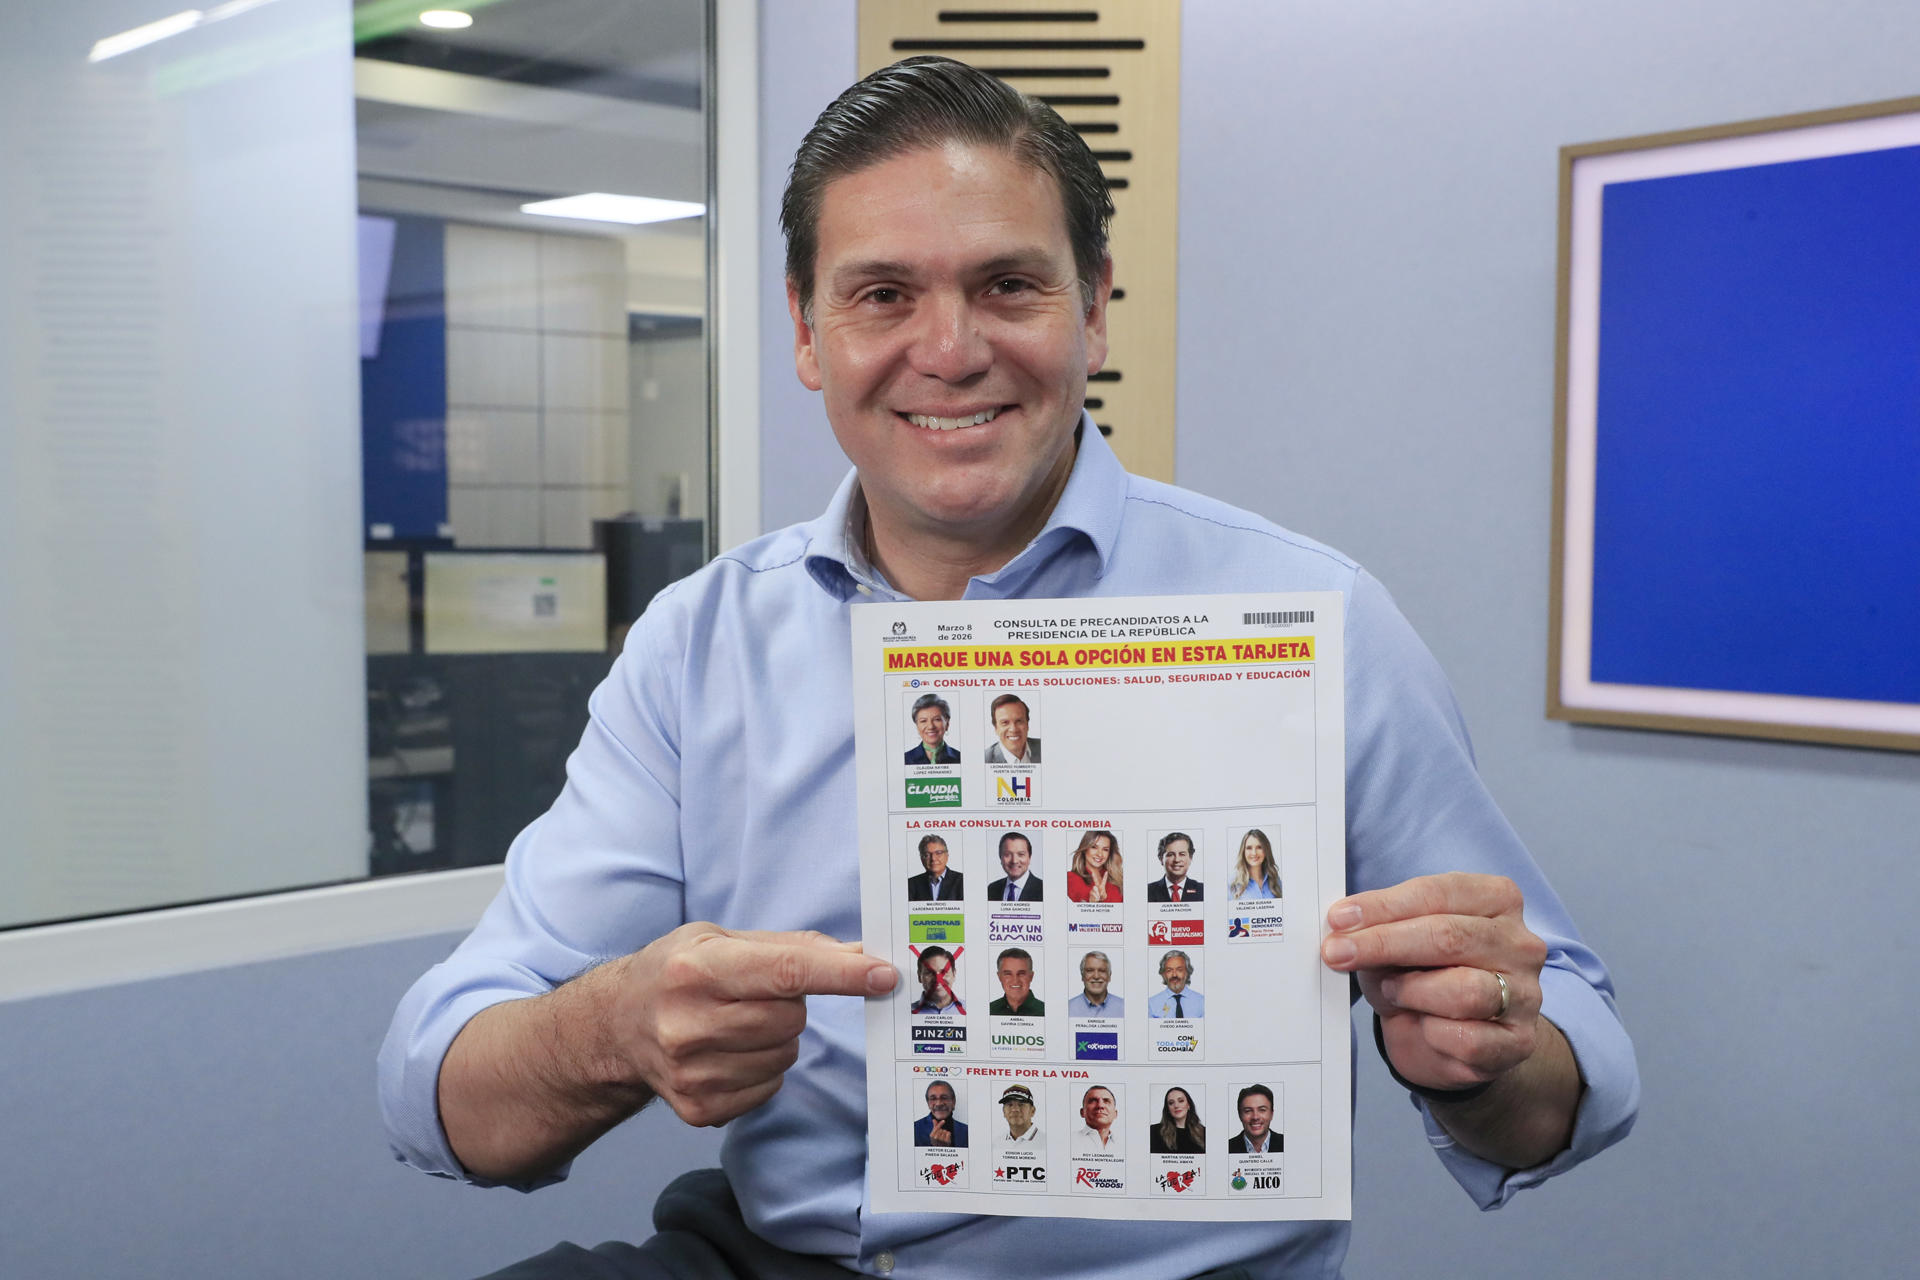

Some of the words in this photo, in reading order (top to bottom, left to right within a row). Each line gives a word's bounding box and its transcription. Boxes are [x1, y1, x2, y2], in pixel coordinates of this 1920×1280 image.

[994, 619, 1057, 628] CONSULTA
[1061, 618, 1076, 627] DE
[1080, 616, 1180, 626] PRECANDIDATOS
[1183, 615, 1191, 623] A
[1194, 615, 1209, 623] LA
[1008, 630, 1088, 639] PRESIDENCIA
[1091, 629, 1107, 638] DE
[1110, 629, 1126, 637] LA
[1129, 626, 1196, 637] REPÚBLICA
[888, 652, 968, 668] MARQUE
[974, 651, 1014, 666] UNA
[1020, 650, 1069, 666] SOLA
[1075, 645, 1146, 665] OPCIÓN
[1152, 647, 1176, 663] EN
[1182, 646, 1227, 662] ESTA
[1232, 642, 1311, 660] TARJETA
[933, 679, 996, 687] CONSULTA
[1000, 678, 1014, 686] DE
[1018, 678, 1040, 686] LAS
[1043, 676, 1120, 686] SOLUCIONES:
[1124, 675, 1165, 685] SALUD,
[1168, 673, 1232, 683] SEGURIDAD
[1235, 672, 1243, 680] Y
[1246, 668, 1311, 680] EDUCACIÓN
[907, 784, 959, 795] CLAUDIA
[924, 820, 956, 828] GRAN
[959, 820, 1021, 828] CONSULTA
[1051, 820, 1112, 828] COLOMBIA
[1251, 916, 1283, 924] CENTRO
[1002, 925, 1024, 933] HAY
[1026, 925, 1042, 933] UN
[1102, 924, 1122, 932] VICKY
[989, 934, 1043, 942] CAMINO
[991, 1035, 1045, 1046] UNIDOS
[966, 1068, 1012, 1076] FRENTE
[1016, 1069, 1039, 1077] POR
[1061, 1070, 1089, 1078] VIDA
[920, 1168, 930, 1176] LA
[1006, 1166, 1046, 1181] PTC
[1076, 1167, 1100, 1189] ROY
[1155, 1174, 1165, 1183] LA
[1253, 1176, 1281, 1189] AICO
